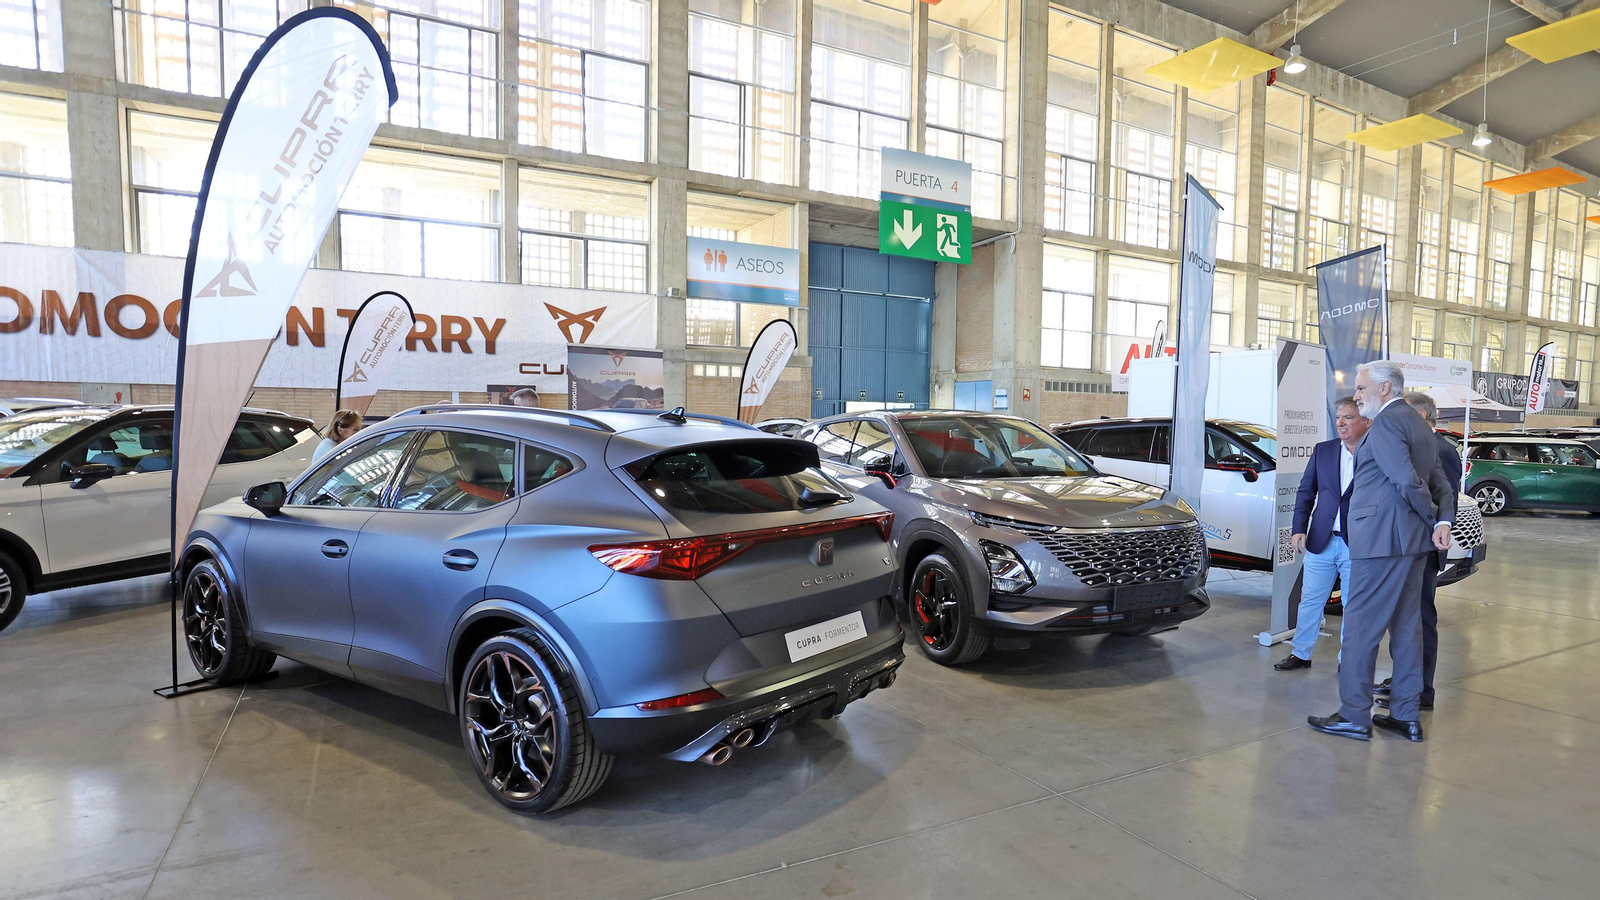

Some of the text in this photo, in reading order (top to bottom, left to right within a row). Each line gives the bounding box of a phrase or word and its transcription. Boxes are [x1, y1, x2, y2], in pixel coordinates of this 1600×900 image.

[333, 66, 375, 126] TRRY
[895, 169, 959, 193] PUERTA 4
[736, 257, 784, 275] ASEOS
[360, 305, 400, 364] CUPRA
[369, 310, 408, 369] AUTOMOCIÓN TERRY
[755, 332, 789, 380] CUPRA
[1529, 383, 1540, 411] AUTO
[1223, 528, 1233, 540] 5
[796, 622, 860, 650] CUPRA FORMENTOR
